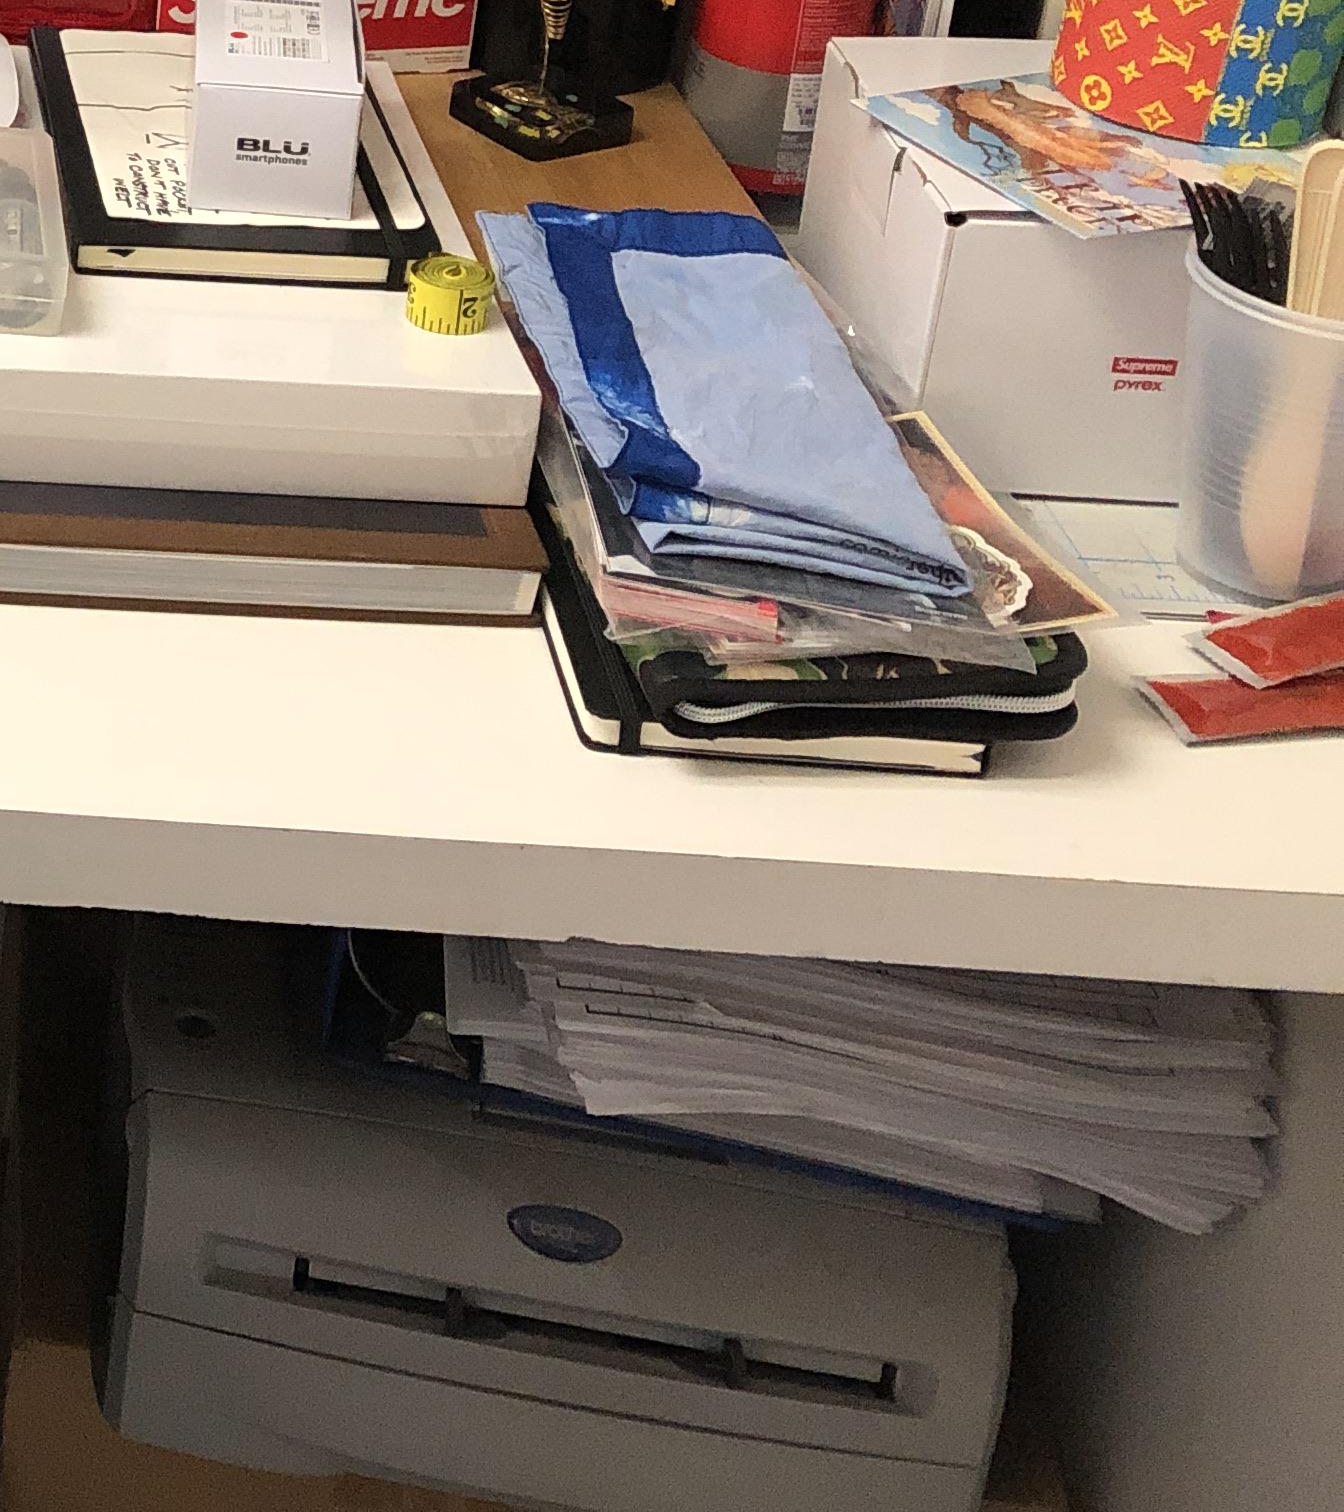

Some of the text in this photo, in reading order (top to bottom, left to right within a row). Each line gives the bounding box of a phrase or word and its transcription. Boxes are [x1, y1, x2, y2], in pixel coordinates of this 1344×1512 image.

[236, 153, 308, 166] smartphones
[462, 297, 478, 318] 2
[1117, 359, 1173, 372] Supreme
[1113, 380, 1162, 391] pyrex
